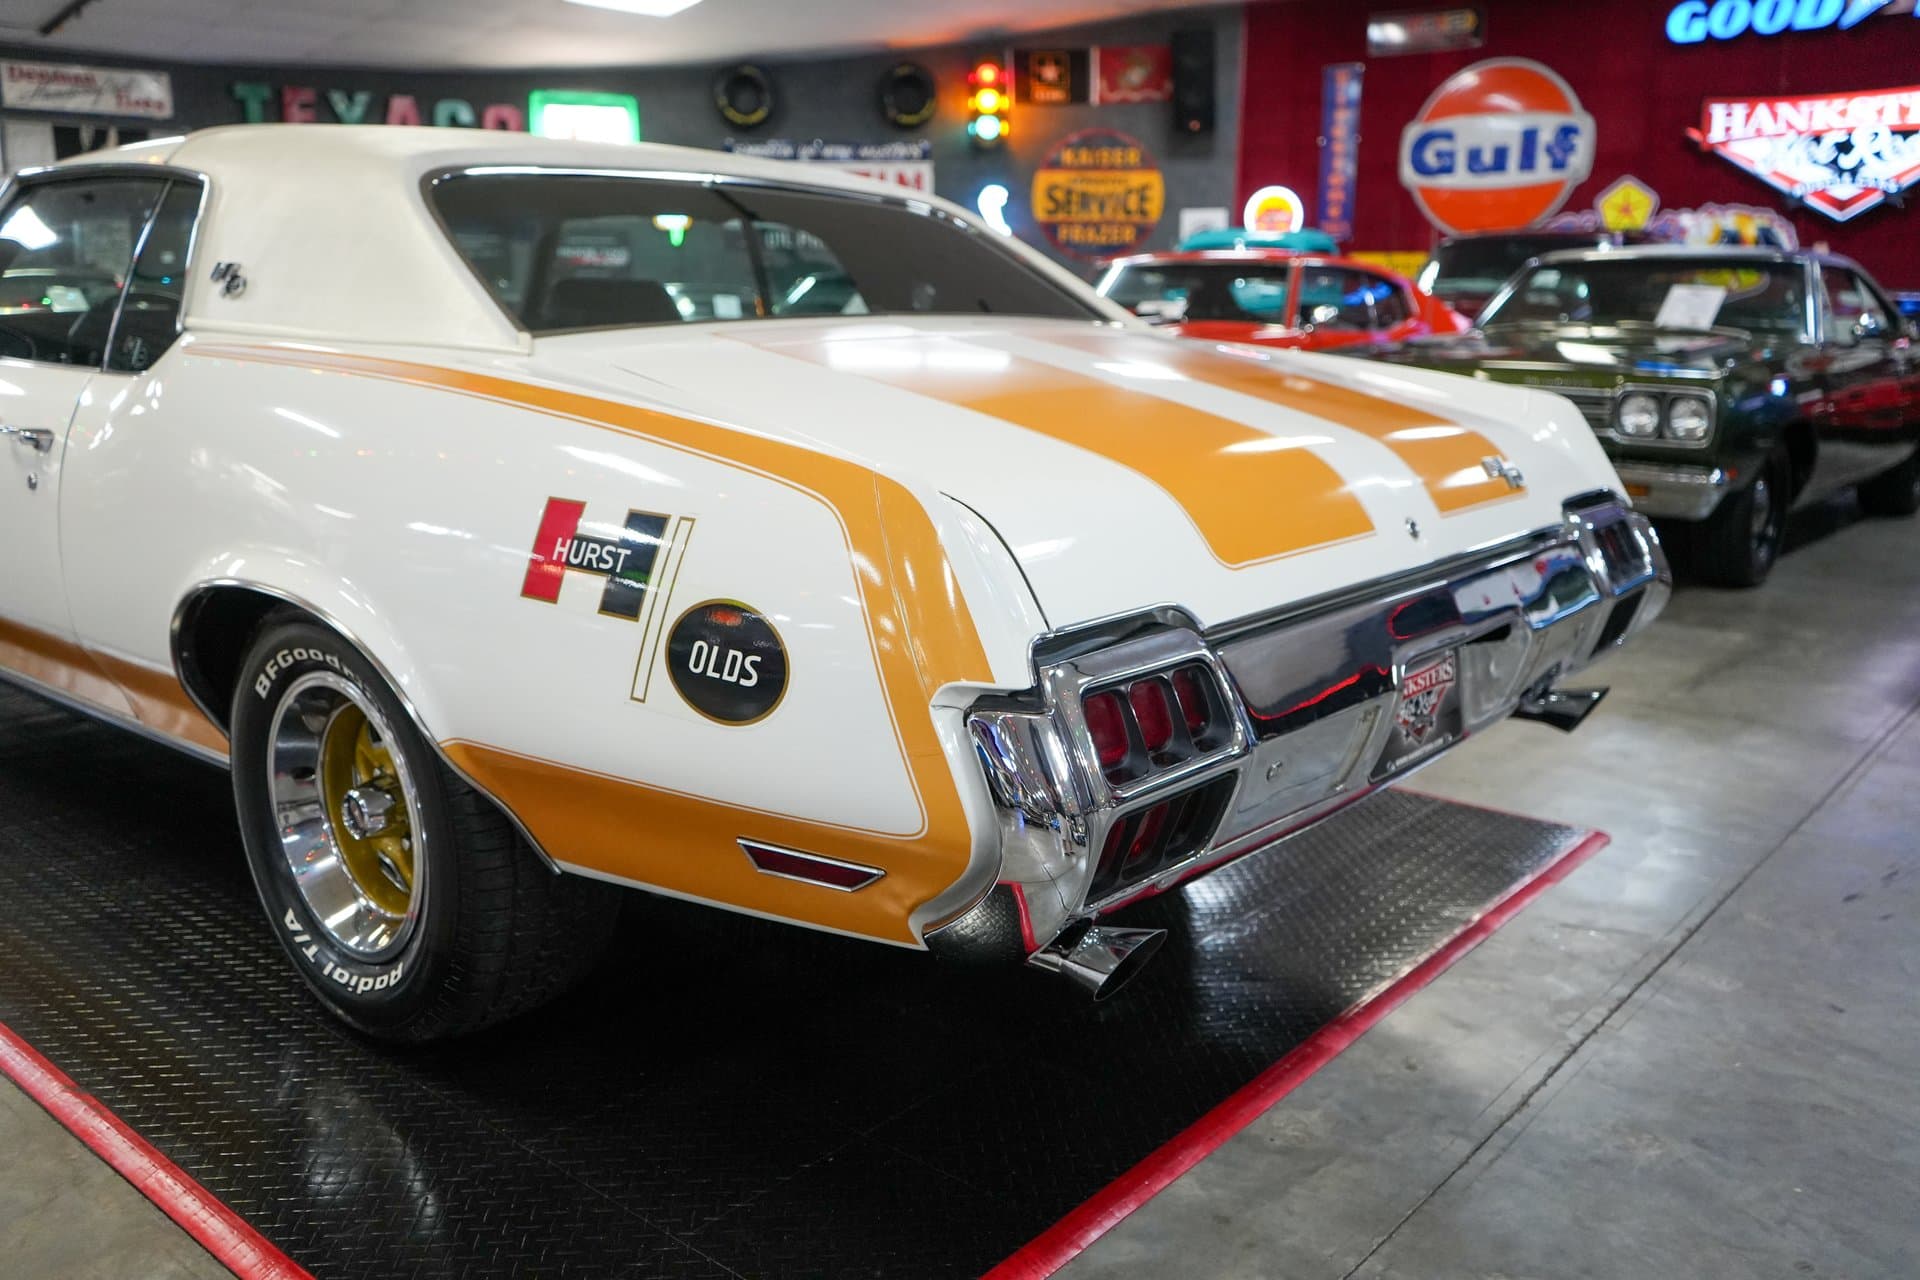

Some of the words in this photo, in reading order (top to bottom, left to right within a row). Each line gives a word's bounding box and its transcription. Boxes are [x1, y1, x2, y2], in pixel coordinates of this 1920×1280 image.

[1411, 124, 1580, 176] Gulf
[1046, 184, 1153, 216] SERVICE
[1057, 223, 1137, 245] FRAZER
[552, 537, 632, 573] HURST
[688, 640, 762, 688] OLDS
[322, 961, 404, 994] Radial
